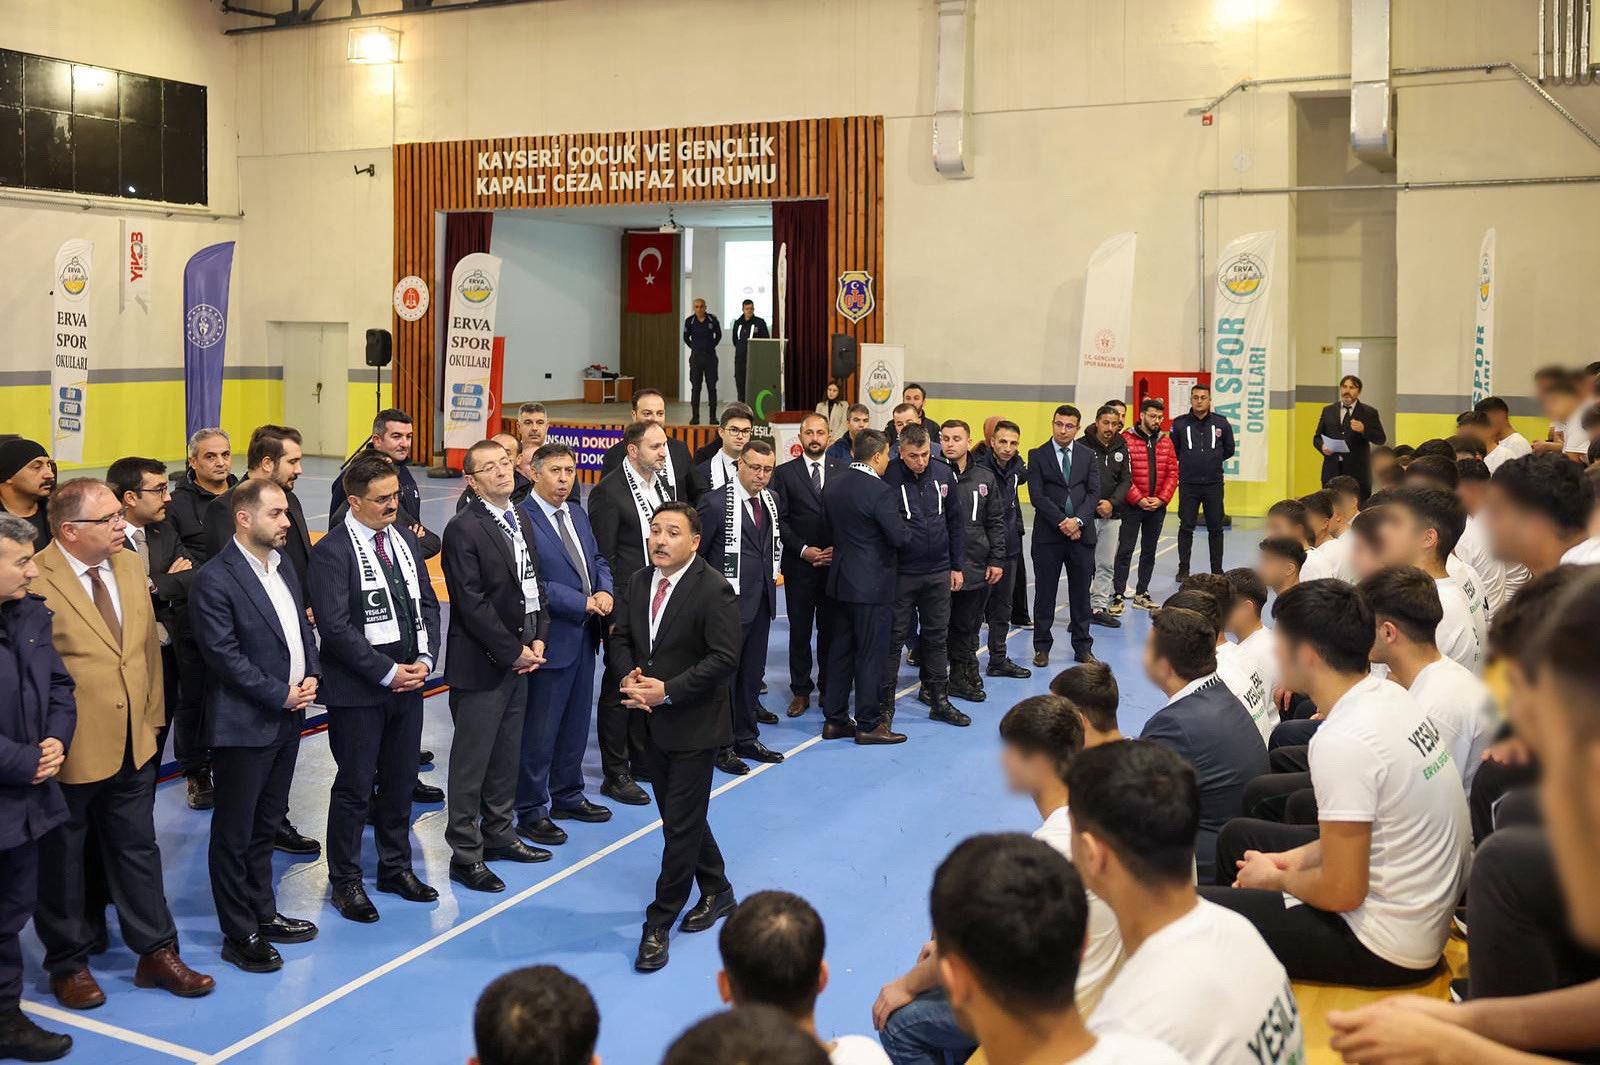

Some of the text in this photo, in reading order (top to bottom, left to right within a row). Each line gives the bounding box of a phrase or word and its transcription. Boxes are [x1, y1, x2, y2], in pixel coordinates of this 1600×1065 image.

[478, 132, 776, 171] KAYSERİ ÇOCUK VE GENÇLİK
[476, 163, 777, 196] KAPALI CEZA İNFAZ KURUMU
[1233, 265, 1254, 273] ERVA
[56, 311, 88, 328] ERVA
[453, 316, 492, 332] ERVA
[56, 333, 88, 350] SPOR
[451, 336, 491, 351] SPOR
[55, 354, 88, 370] OKULLARI
[449, 354, 491, 369] OKULLARI
[1215, 317, 1245, 394] SPOR
[1247, 347, 1267, 433] OKULLARI
[581, 453, 605, 465] DOK
